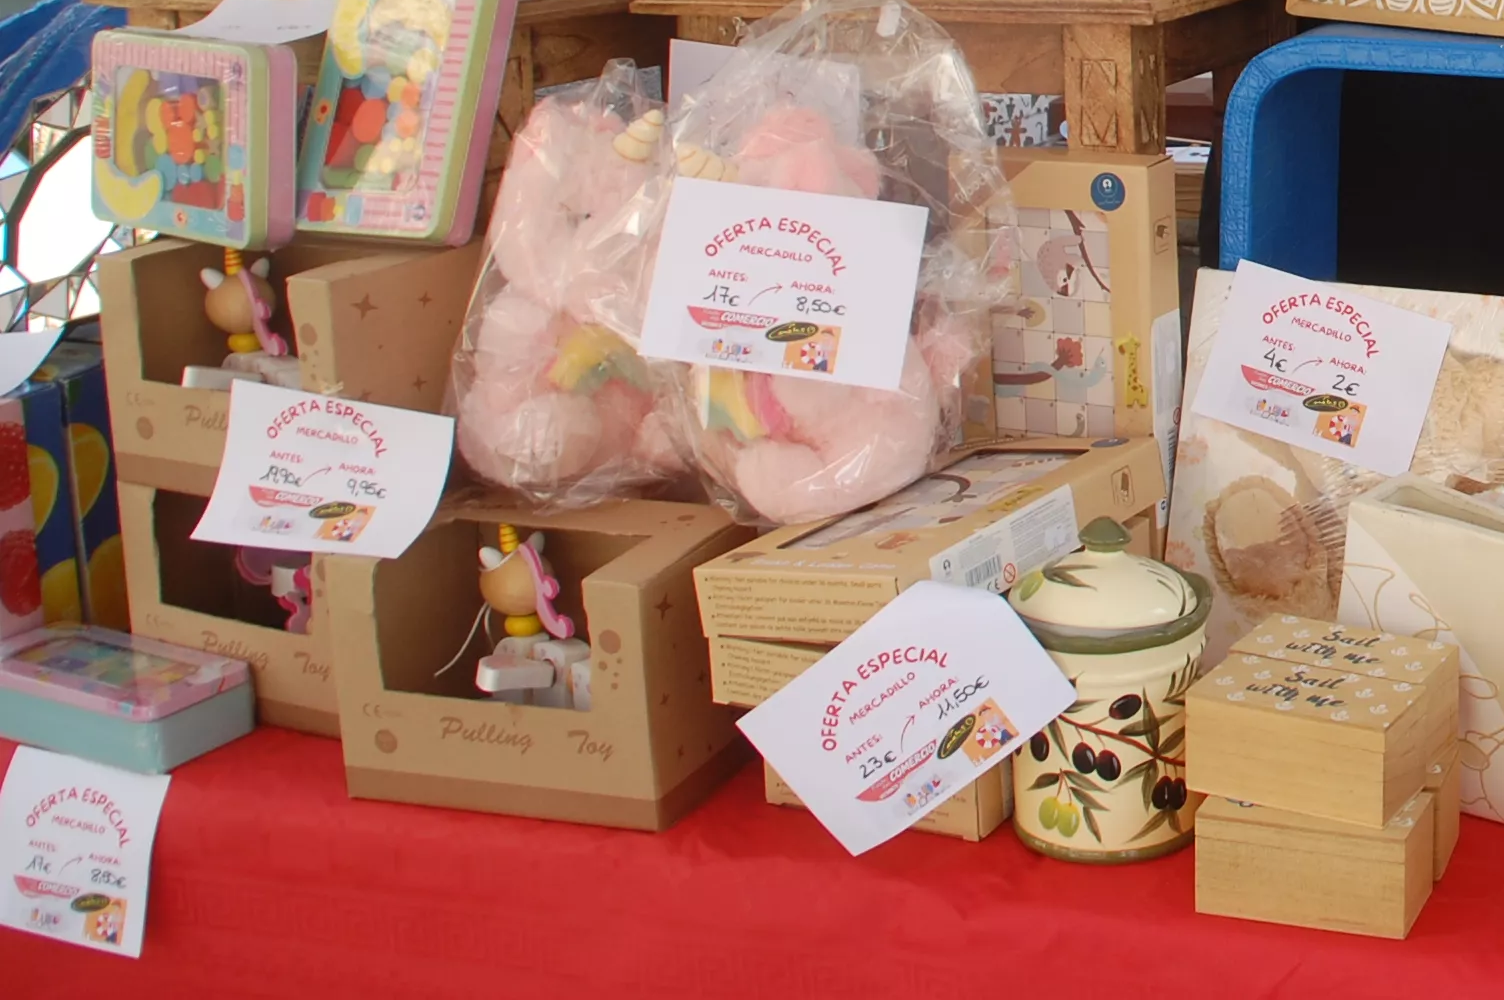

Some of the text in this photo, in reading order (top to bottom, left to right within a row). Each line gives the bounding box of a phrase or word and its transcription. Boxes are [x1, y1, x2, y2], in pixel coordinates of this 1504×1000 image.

[704, 216, 847, 277] OFERTA ESPECIAL
[739, 244, 813, 263] MERCADILLO
[703, 284, 847, 316] 17€ 8,50€
[1262, 293, 1380, 358] OFERTA ESPECIAL
[1291, 317, 1352, 342] MERCADILLO
[1263, 347, 1360, 396] 4€ 2€
[266, 399, 388, 459] OFERTA ESPECIAL
[295, 426, 360, 445] MERCADILLO
[1285, 641, 1384, 665] with me
[1322, 630, 1381, 648] Sail
[293, 651, 333, 686] Toy
[1285, 671, 1347, 690] Sail
[821, 679, 858, 752] OFERTA
[857, 646, 949, 681] ESPECIAL
[849, 671, 916, 726] MERCADILLO
[1246, 683, 1348, 708] with me
[438, 715, 614, 763] Pulling Toy
[845, 676, 960, 765] ANTES: AHORA:
[859, 674, 991, 780] 23€ 11,50€
[25, 787, 131, 848] OFERTA ESPECIAL
